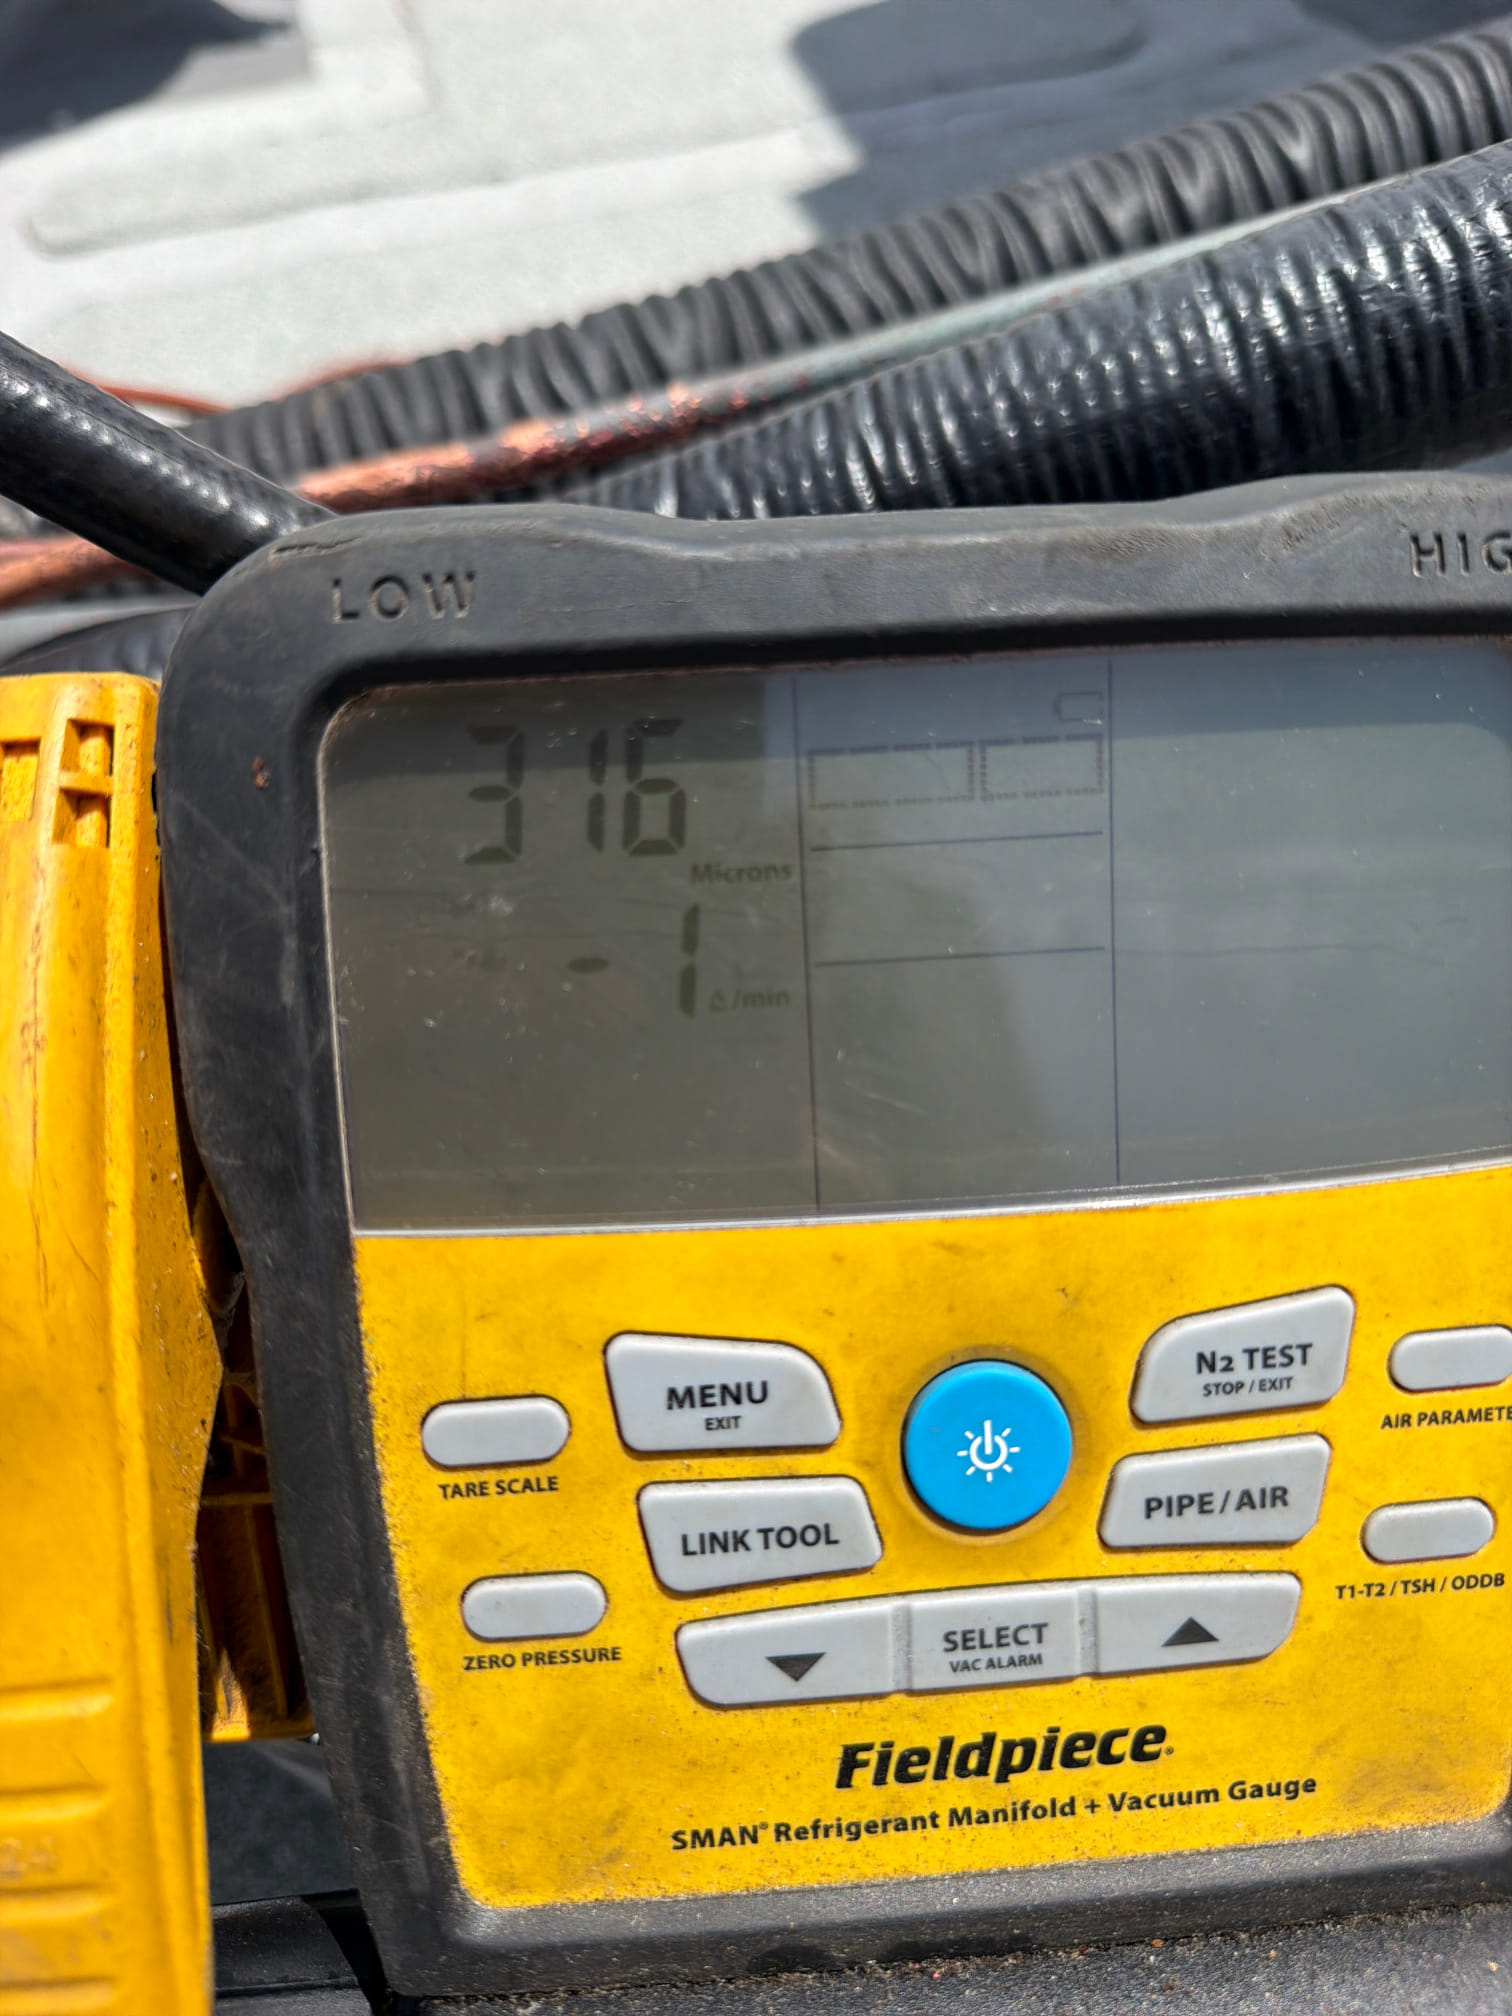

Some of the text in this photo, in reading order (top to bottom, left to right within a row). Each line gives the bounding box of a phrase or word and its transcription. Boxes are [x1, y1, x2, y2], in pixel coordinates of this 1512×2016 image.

[332, 570, 476, 623] LOW
[464, 718, 686, 864] 316
[690, 863, 793, 884] Microns
[1196, 1342, 1312, 1375] N2 TEST
[666, 1380, 768, 1411] MENU
[1203, 1381, 1245, 1397] STOP
[1258, 1376, 1293, 1392] EXIT
[705, 1415, 741, 1431] EXIT
[1380, 1413, 1412, 1430] AIR
[438, 1475, 559, 1500] TARE SCALE
[681, 1523, 840, 1556] LINK TOOL
[1336, 1583, 1386, 1600] T1-T2
[1400, 1578, 1436, 1595] TSH
[1451, 1572, 1505, 1591] ODDB
[943, 1622, 1049, 1652] SELECT
[463, 1647, 622, 1671] ZERO PRESSURE
[949, 1653, 1043, 1673] VAC ALARM
[774, 1810, 940, 1842] Refrigerant
[948, 1796, 1077, 1828] Manifold
[1107, 1785, 1220, 1813] Vacuum
[1227, 1776, 1317, 1801] Gauge
